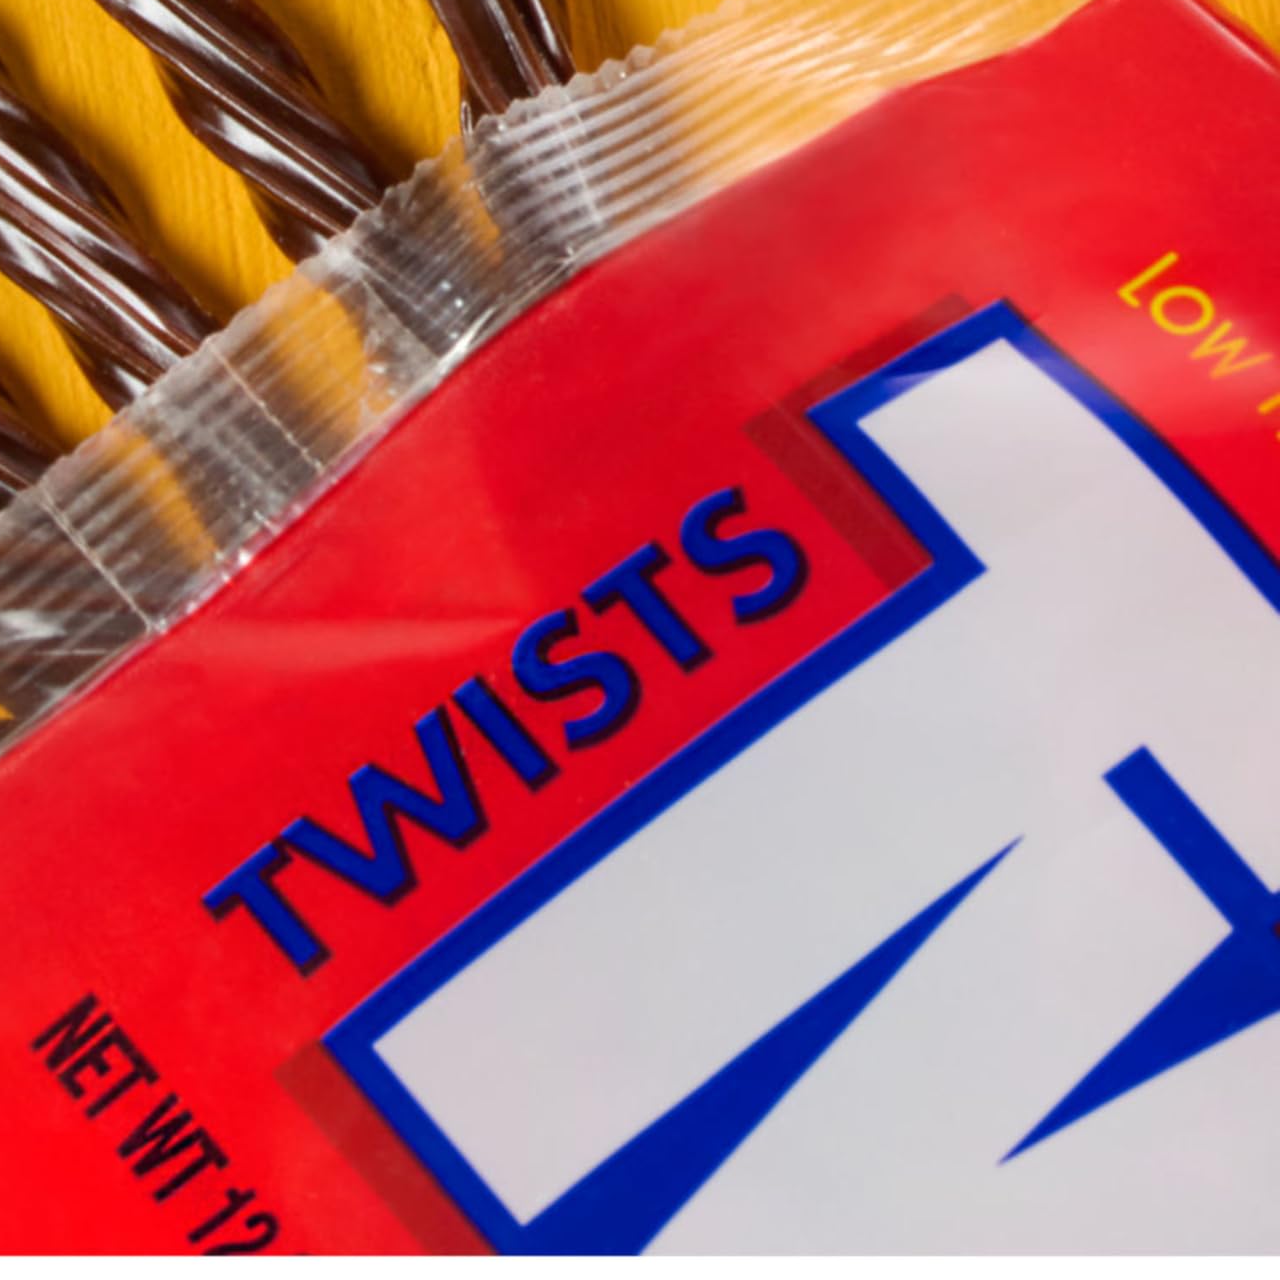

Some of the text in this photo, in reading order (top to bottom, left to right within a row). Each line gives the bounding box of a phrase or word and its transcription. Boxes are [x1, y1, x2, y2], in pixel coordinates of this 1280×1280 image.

[1117, 251, 1272, 379] LOW
[201, 485, 811, 978] TWISTS
[30, 992, 160, 1119] NET
[116, 1092, 229, 1203] WT
